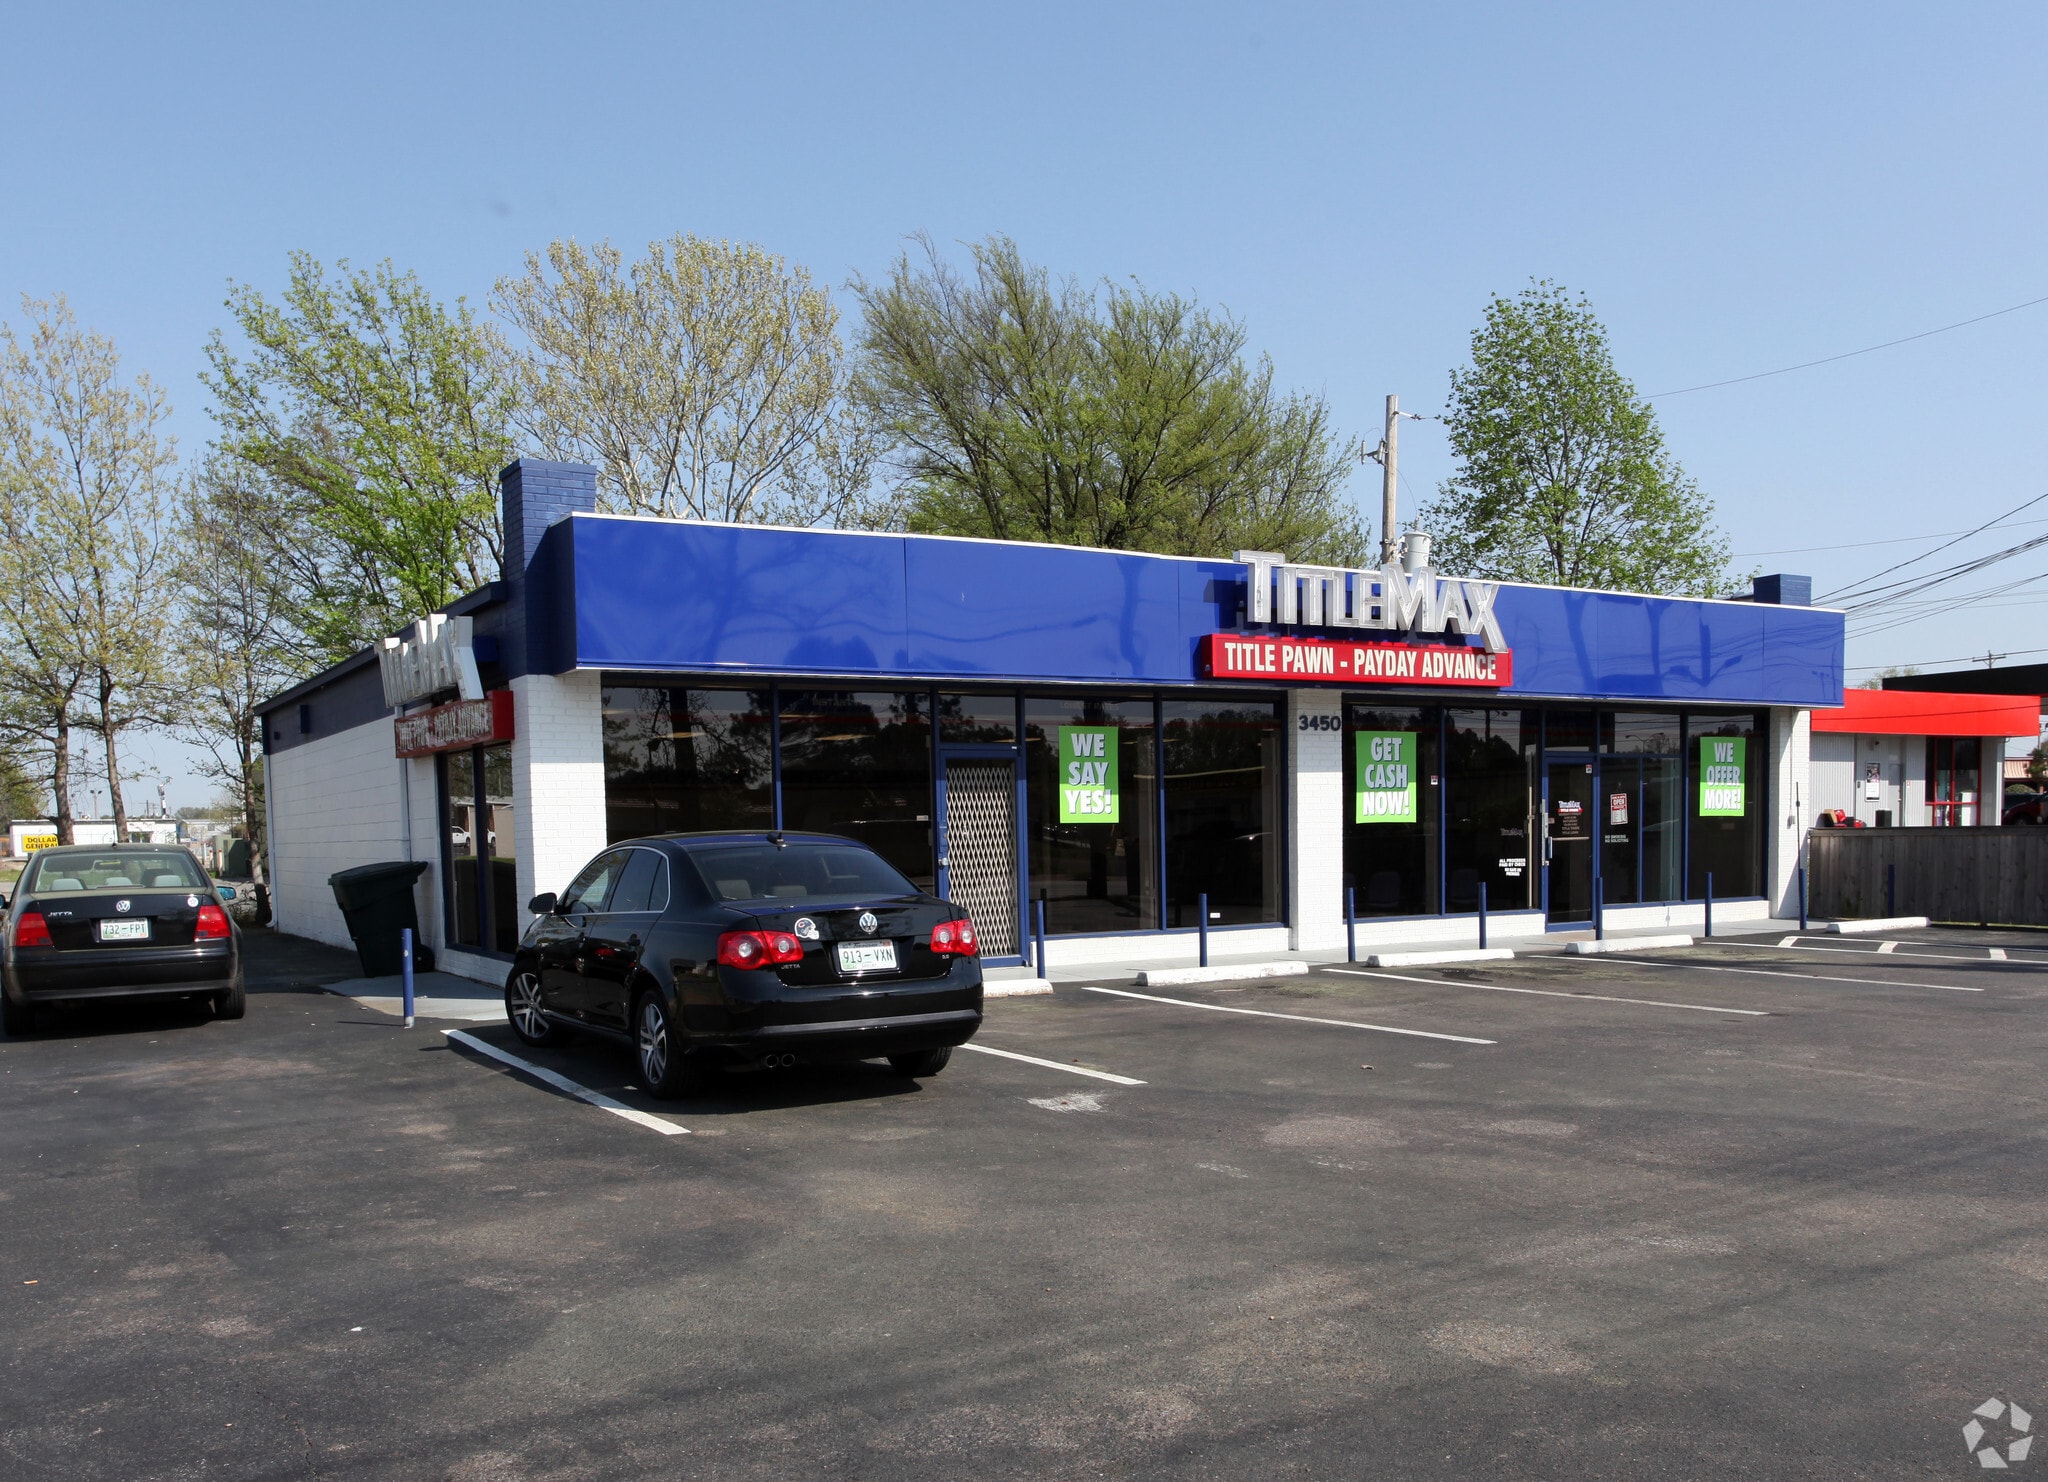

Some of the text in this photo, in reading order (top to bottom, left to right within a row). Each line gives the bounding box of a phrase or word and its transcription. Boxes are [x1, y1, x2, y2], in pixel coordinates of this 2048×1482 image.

[1224, 642, 1276, 672] TITLE
[1282, 645, 1334, 674] PAWN
[1354, 648, 1417, 678] PAYDAY
[1422, 651, 1497, 680] ADVANCE
[1298, 715, 1341, 731] 3450
[1070, 733, 1105, 757] WE
[1371, 737, 1402, 761] GET
[1714, 742, 1734, 763] WE
[1068, 761, 1109, 786] SAY
[1365, 764, 1408, 789] CASH
[1706, 765, 1741, 787] OFFER
[1065, 789, 1112, 814] YES!
[1363, 790, 1410, 815] NOW!
[1704, 788, 1741, 810] MORE!
